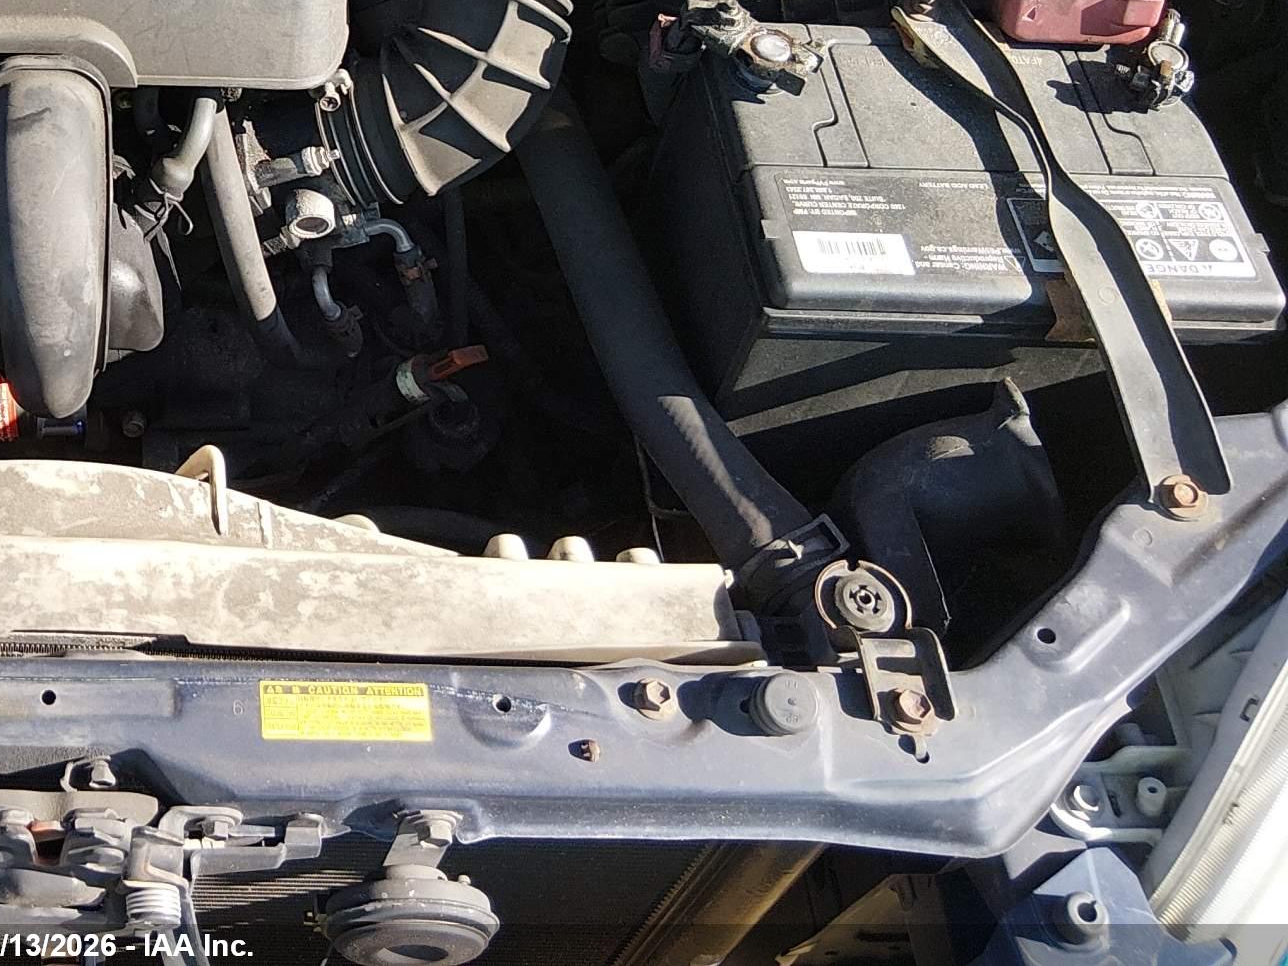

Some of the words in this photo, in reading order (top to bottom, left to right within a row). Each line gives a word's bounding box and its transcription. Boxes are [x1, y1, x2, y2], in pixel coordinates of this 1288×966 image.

[1147, 264, 1199, 273] DANGE
[308, 685, 359, 695] CAUTION
[366, 686, 423, 696] ATTENTION
